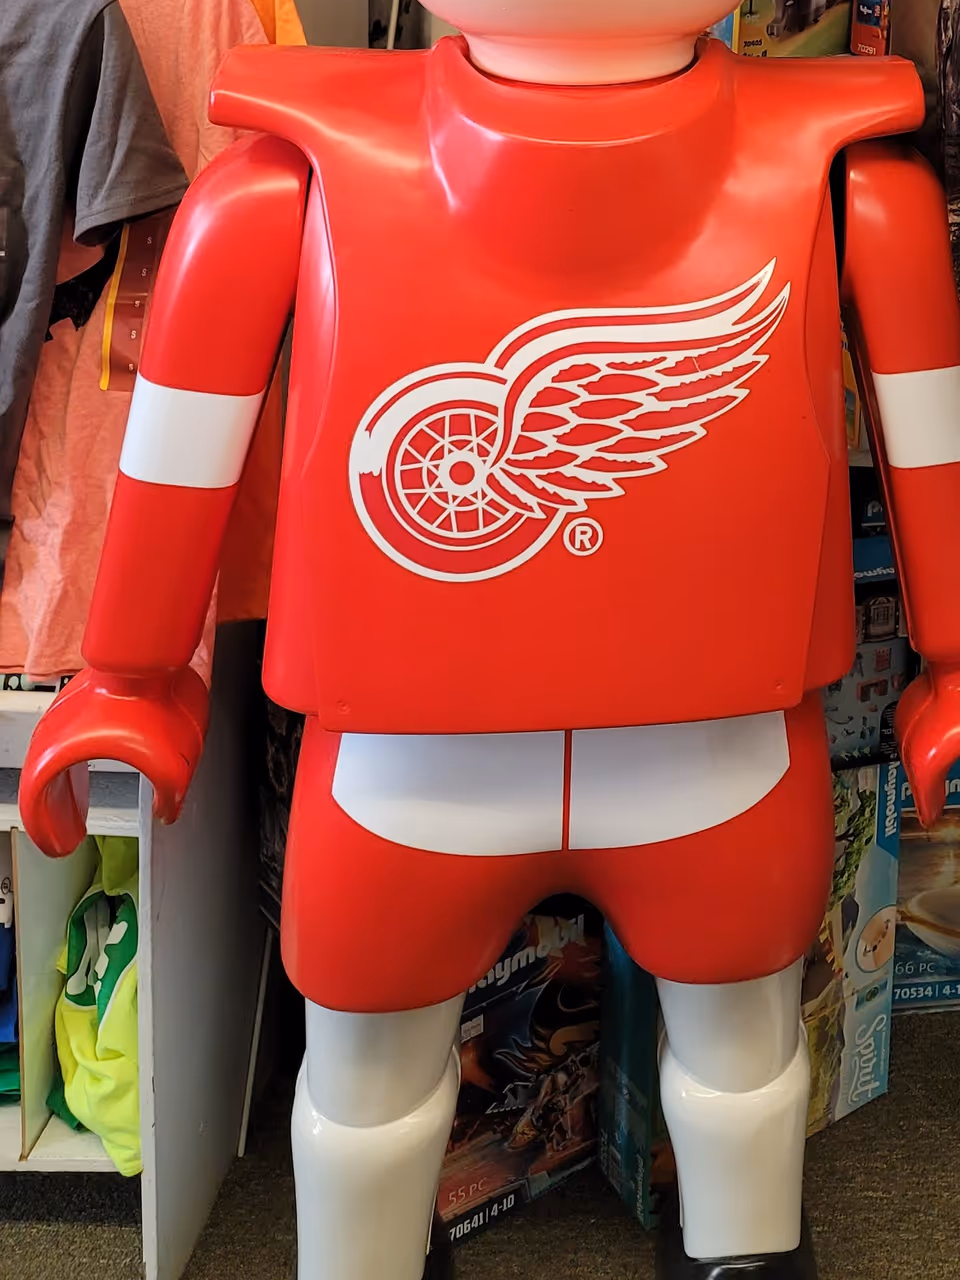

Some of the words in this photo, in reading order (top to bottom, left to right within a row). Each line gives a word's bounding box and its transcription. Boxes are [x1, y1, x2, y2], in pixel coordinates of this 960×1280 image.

[857, 43, 876, 55] 70291
[468, 913, 586, 995] laymobil
[895, 961, 914, 974] 66
[919, 962, 935, 973] PC
[894, 986, 932, 999] 70534
[848, 1014, 886, 1105] Spirit
[449, 1210, 485, 1242] 70641
[491, 1193, 515, 1218] 4-10
